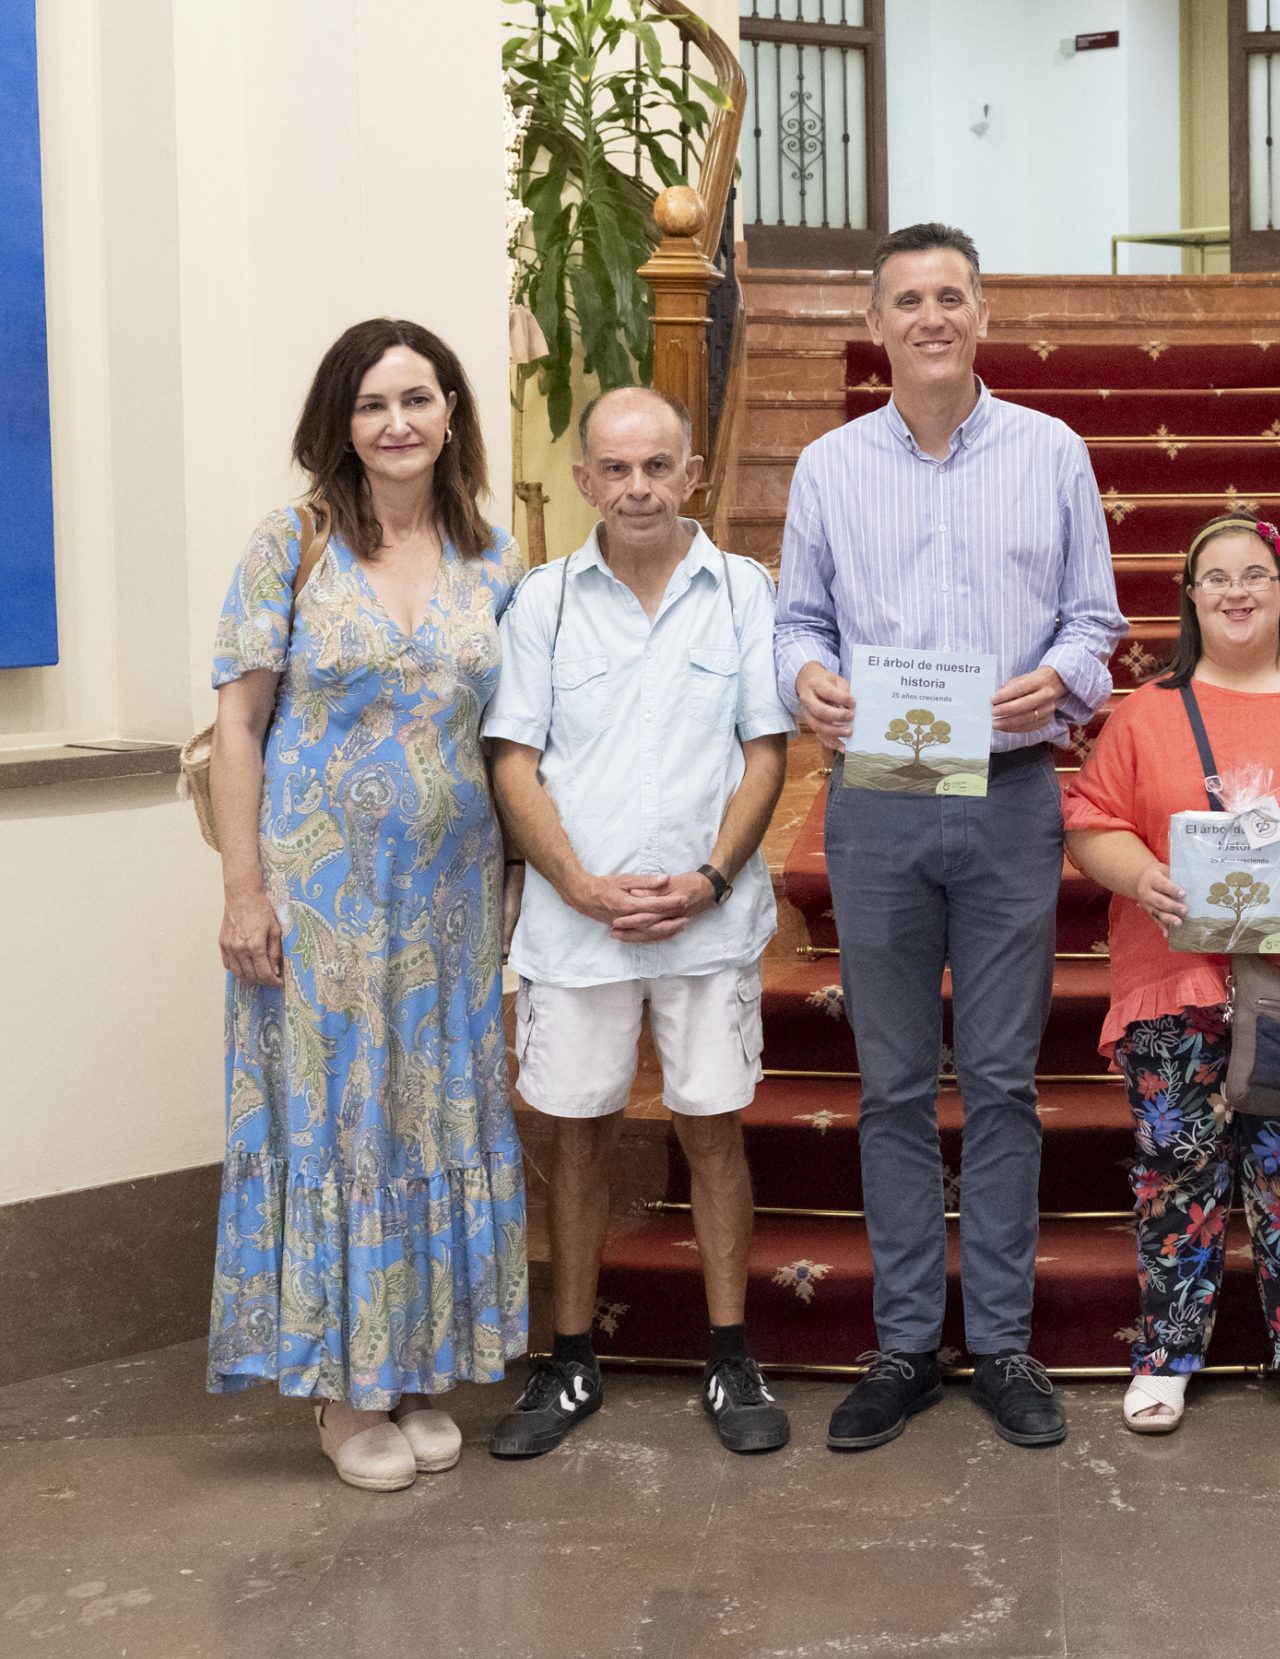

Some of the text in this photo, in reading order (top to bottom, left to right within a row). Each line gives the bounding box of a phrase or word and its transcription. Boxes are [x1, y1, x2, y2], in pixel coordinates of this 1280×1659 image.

[868, 655, 981, 674] El árbol de nuestra
[900, 676, 946, 689] historia
[901, 692, 918, 700] años
[919, 694, 952, 702] creciendo
[1185, 824, 1197, 834] El
[1200, 824, 1228, 834] árbo
